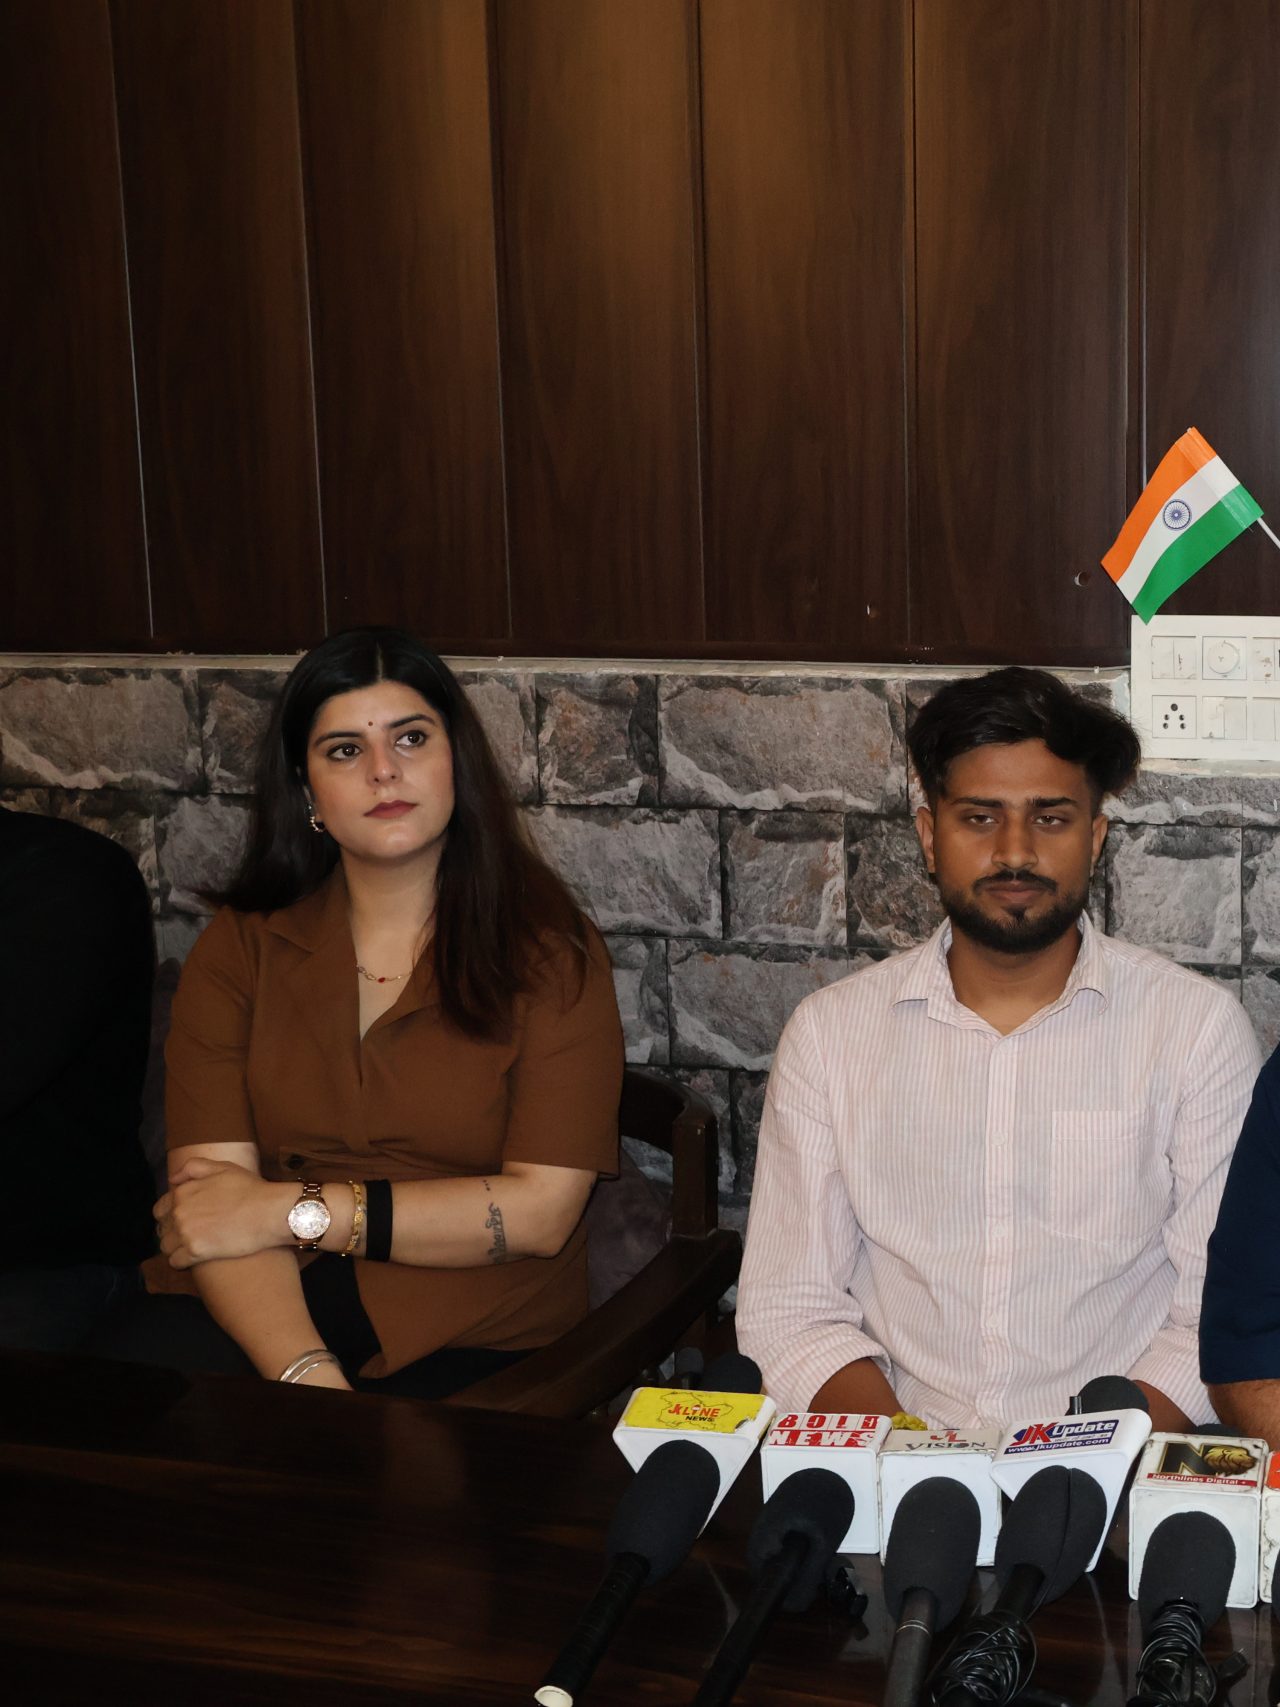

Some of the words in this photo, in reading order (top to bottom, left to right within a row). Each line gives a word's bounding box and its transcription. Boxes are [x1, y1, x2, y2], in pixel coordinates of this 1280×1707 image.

[769, 1430, 876, 1447] NEWS
[1009, 1421, 1059, 1446] JK
[1052, 1421, 1116, 1438] Update
[1152, 1474, 1204, 1483] Northlines
[1206, 1477, 1239, 1486] Digital
